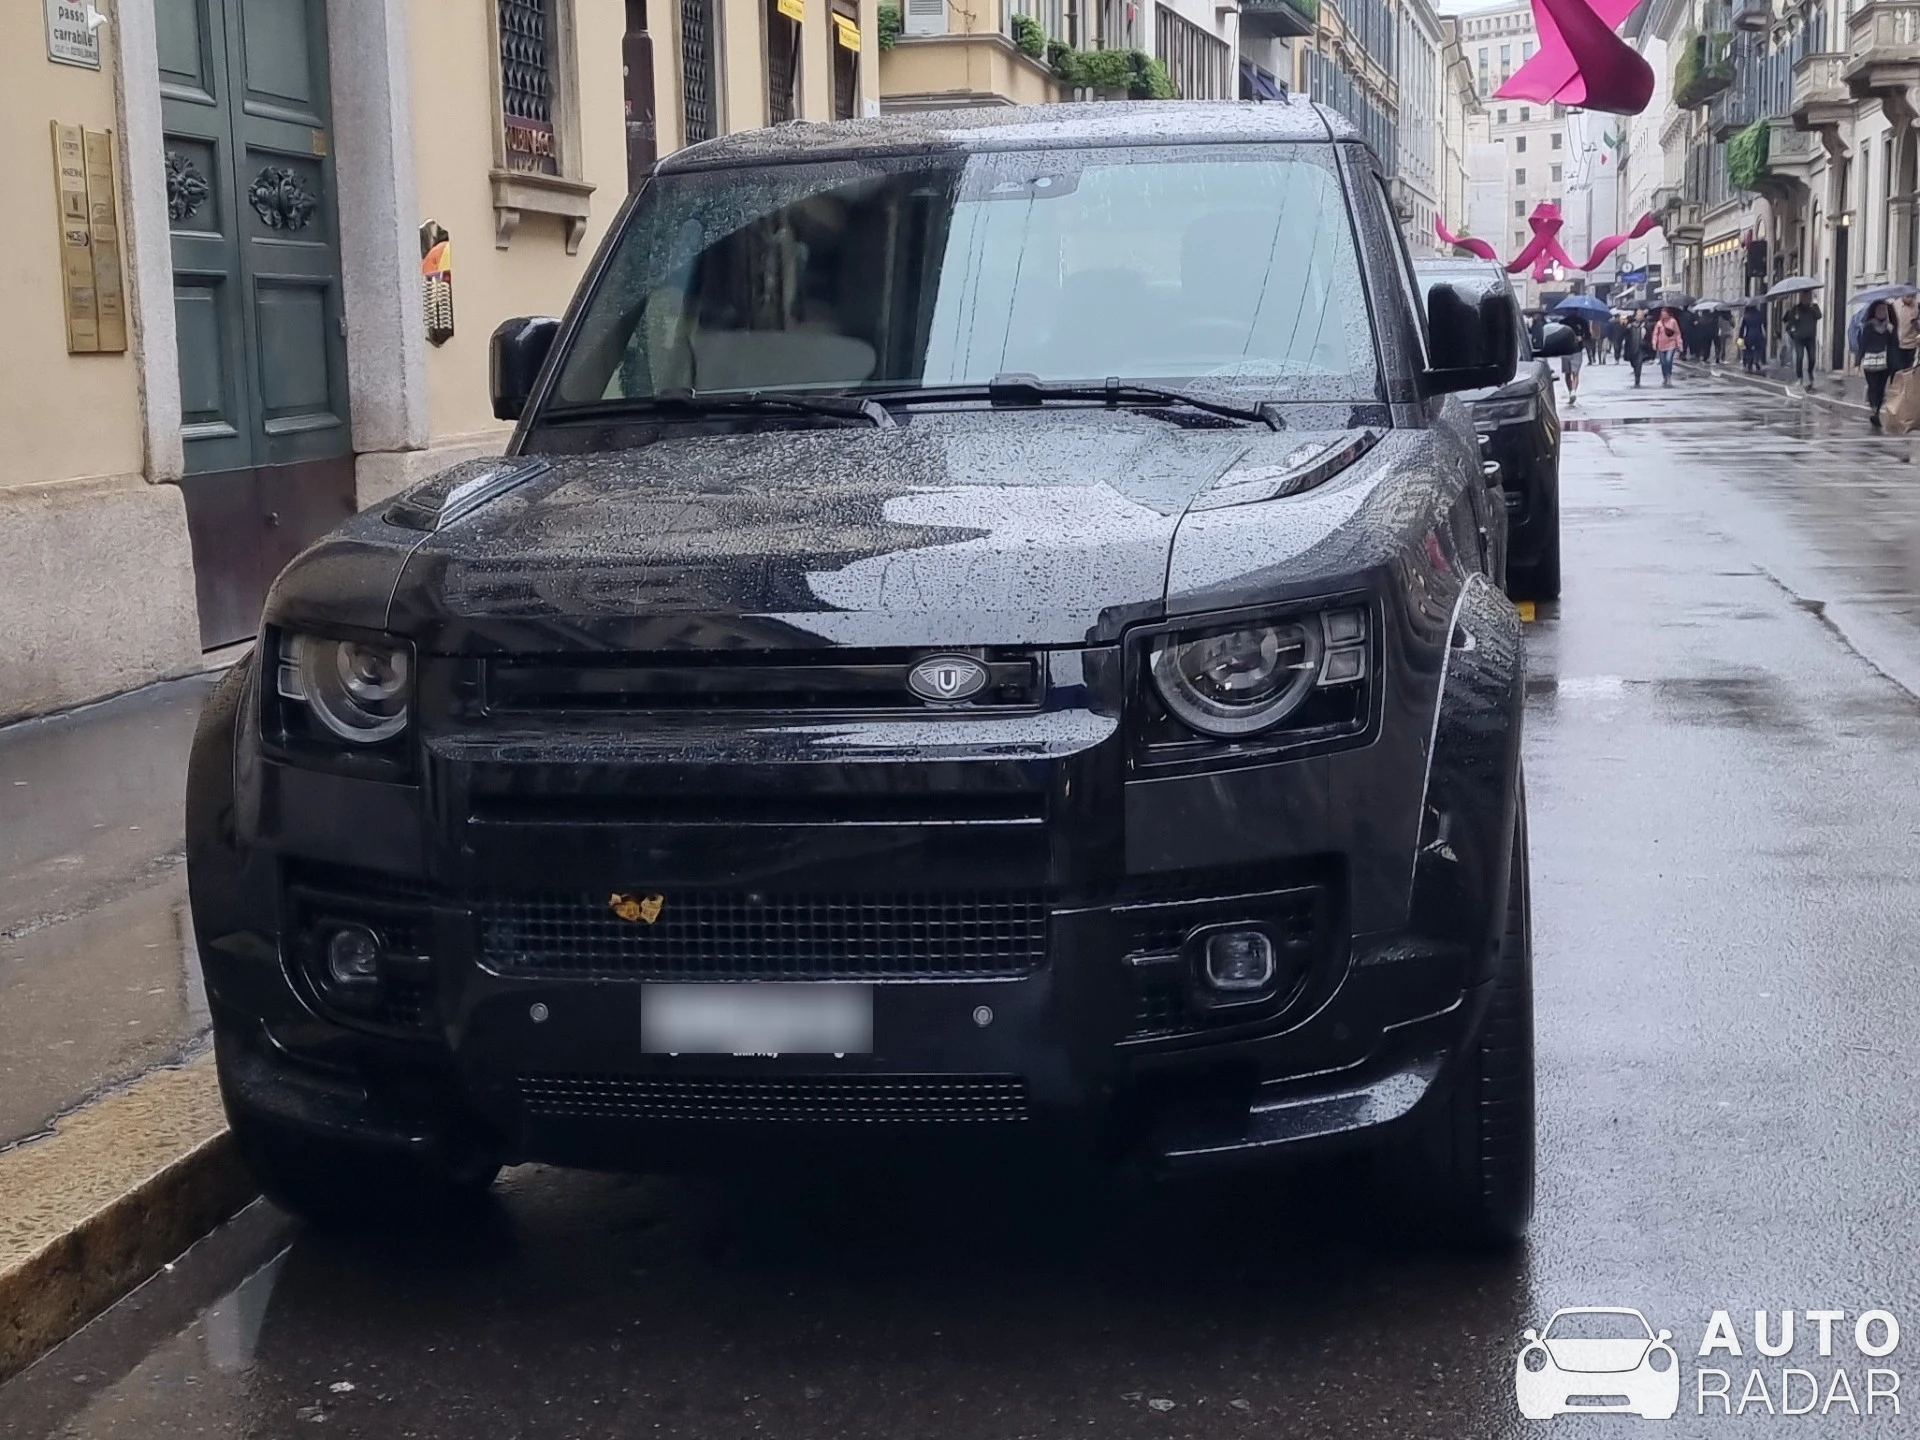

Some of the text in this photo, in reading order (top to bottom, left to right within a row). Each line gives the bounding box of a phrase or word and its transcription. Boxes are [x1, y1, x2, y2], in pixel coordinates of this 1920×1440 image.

[58, 6, 85, 23] passo
[53, 28, 93, 46] carrabile
[940, 672, 955, 690] U
